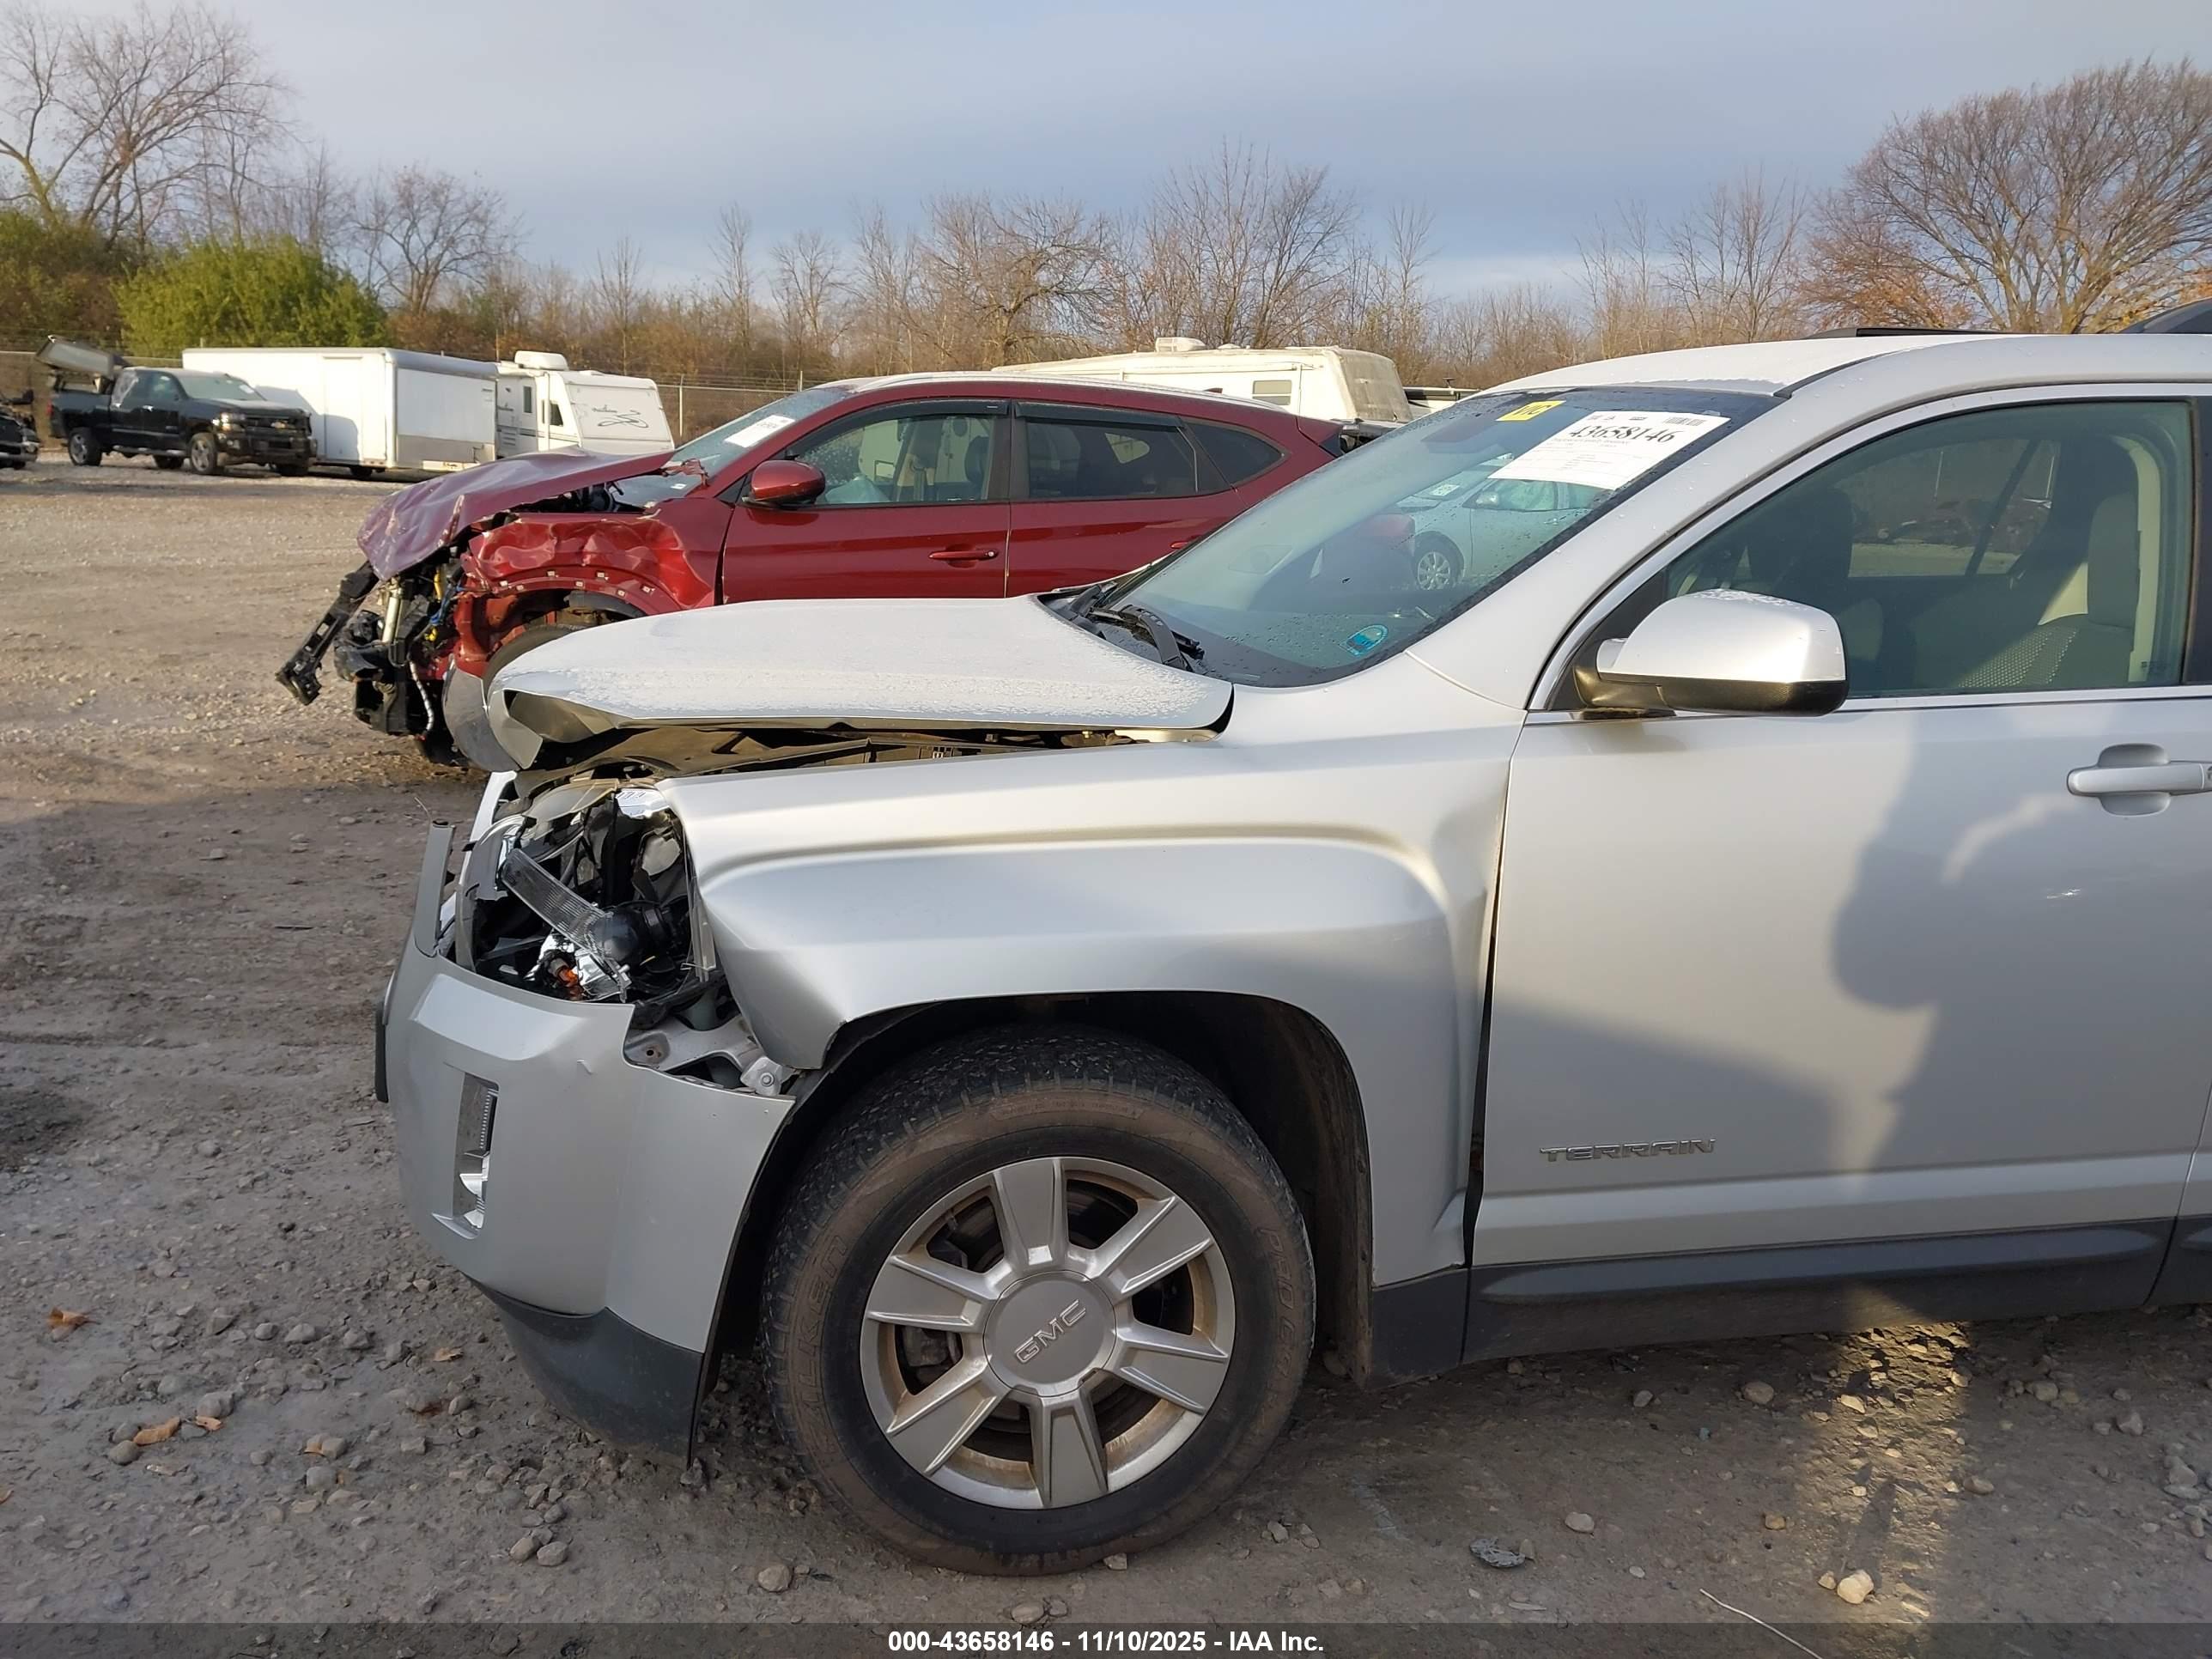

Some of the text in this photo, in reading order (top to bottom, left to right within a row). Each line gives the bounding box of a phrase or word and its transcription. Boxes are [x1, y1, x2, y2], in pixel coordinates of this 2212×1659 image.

[1569, 424, 1682, 443] 43658146
[1539, 1138, 1717, 1162] TERRAIN
[1014, 1299, 1086, 1364] GMC
